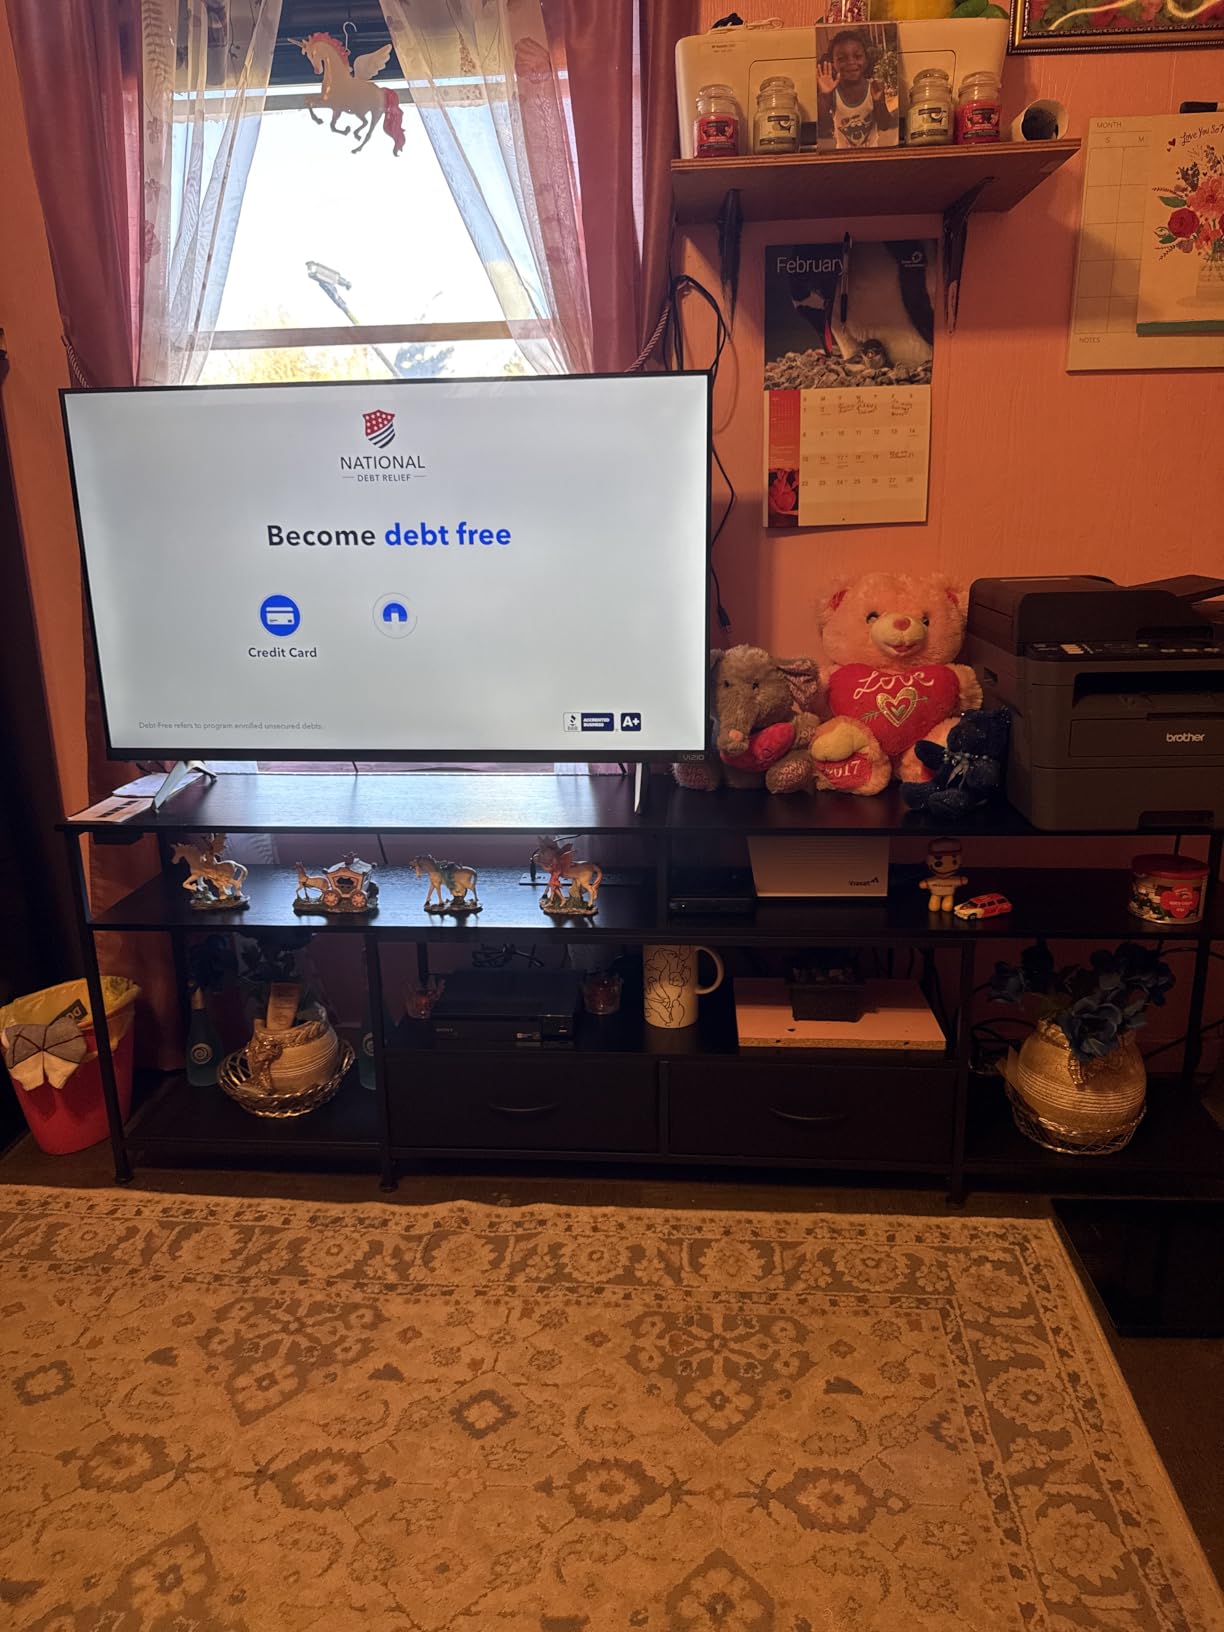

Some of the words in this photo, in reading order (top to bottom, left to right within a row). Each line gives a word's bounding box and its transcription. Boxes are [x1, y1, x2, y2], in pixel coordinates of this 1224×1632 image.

[1096, 121, 1122, 129] MONTH
[1198, 127, 1210, 138] You
[1105, 136, 1111, 144] S
[776, 256, 845, 276] February
[1079, 336, 1101, 344] NOTES
[340, 455, 426, 470] NATIONAL
[357, 474, 381, 482] DEBT
[383, 473, 412, 482] RELIEF
[266, 525, 377, 547] Become
[384, 522, 449, 546] debt
[455, 521, 512, 546] free
[248, 646, 286, 658] Credit
[289, 646, 318, 658] Card
[853, 670, 936, 700] Love
[174, 721, 193, 729] refers
[194, 721, 202, 729] to
[203, 723, 233, 731] program
[234, 721, 263, 729] enrolled
[264, 721, 301, 730] unsecured
[622, 715, 641, 728] A+
[1166, 732, 1206, 743] brother
[682, 753, 705, 761] VIZIO
